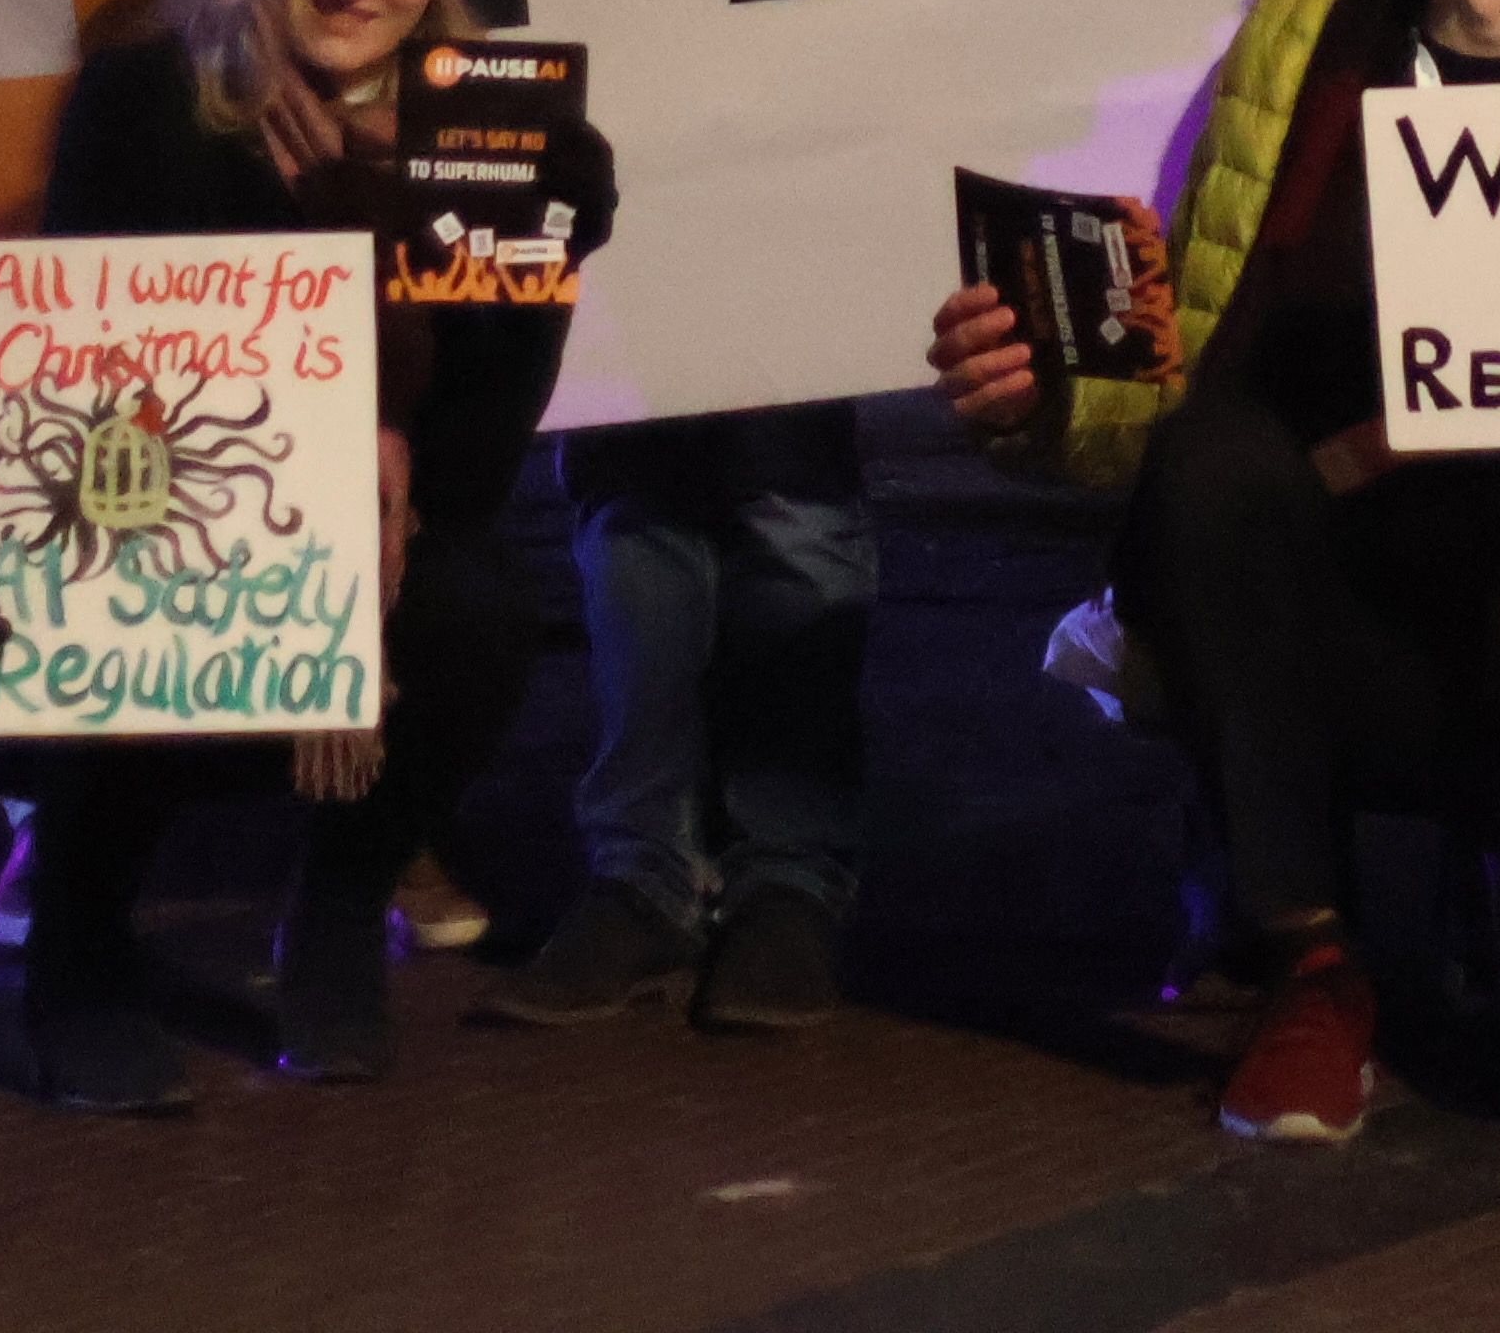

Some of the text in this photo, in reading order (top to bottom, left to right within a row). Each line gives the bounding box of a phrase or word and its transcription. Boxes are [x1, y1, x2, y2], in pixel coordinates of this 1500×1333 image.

[433, 159, 537, 182] SUPERHUM
[97, 259, 109, 312] I
[128, 260, 255, 313] want
[252, 251, 352, 333] for
[295, 326, 344, 382] is
